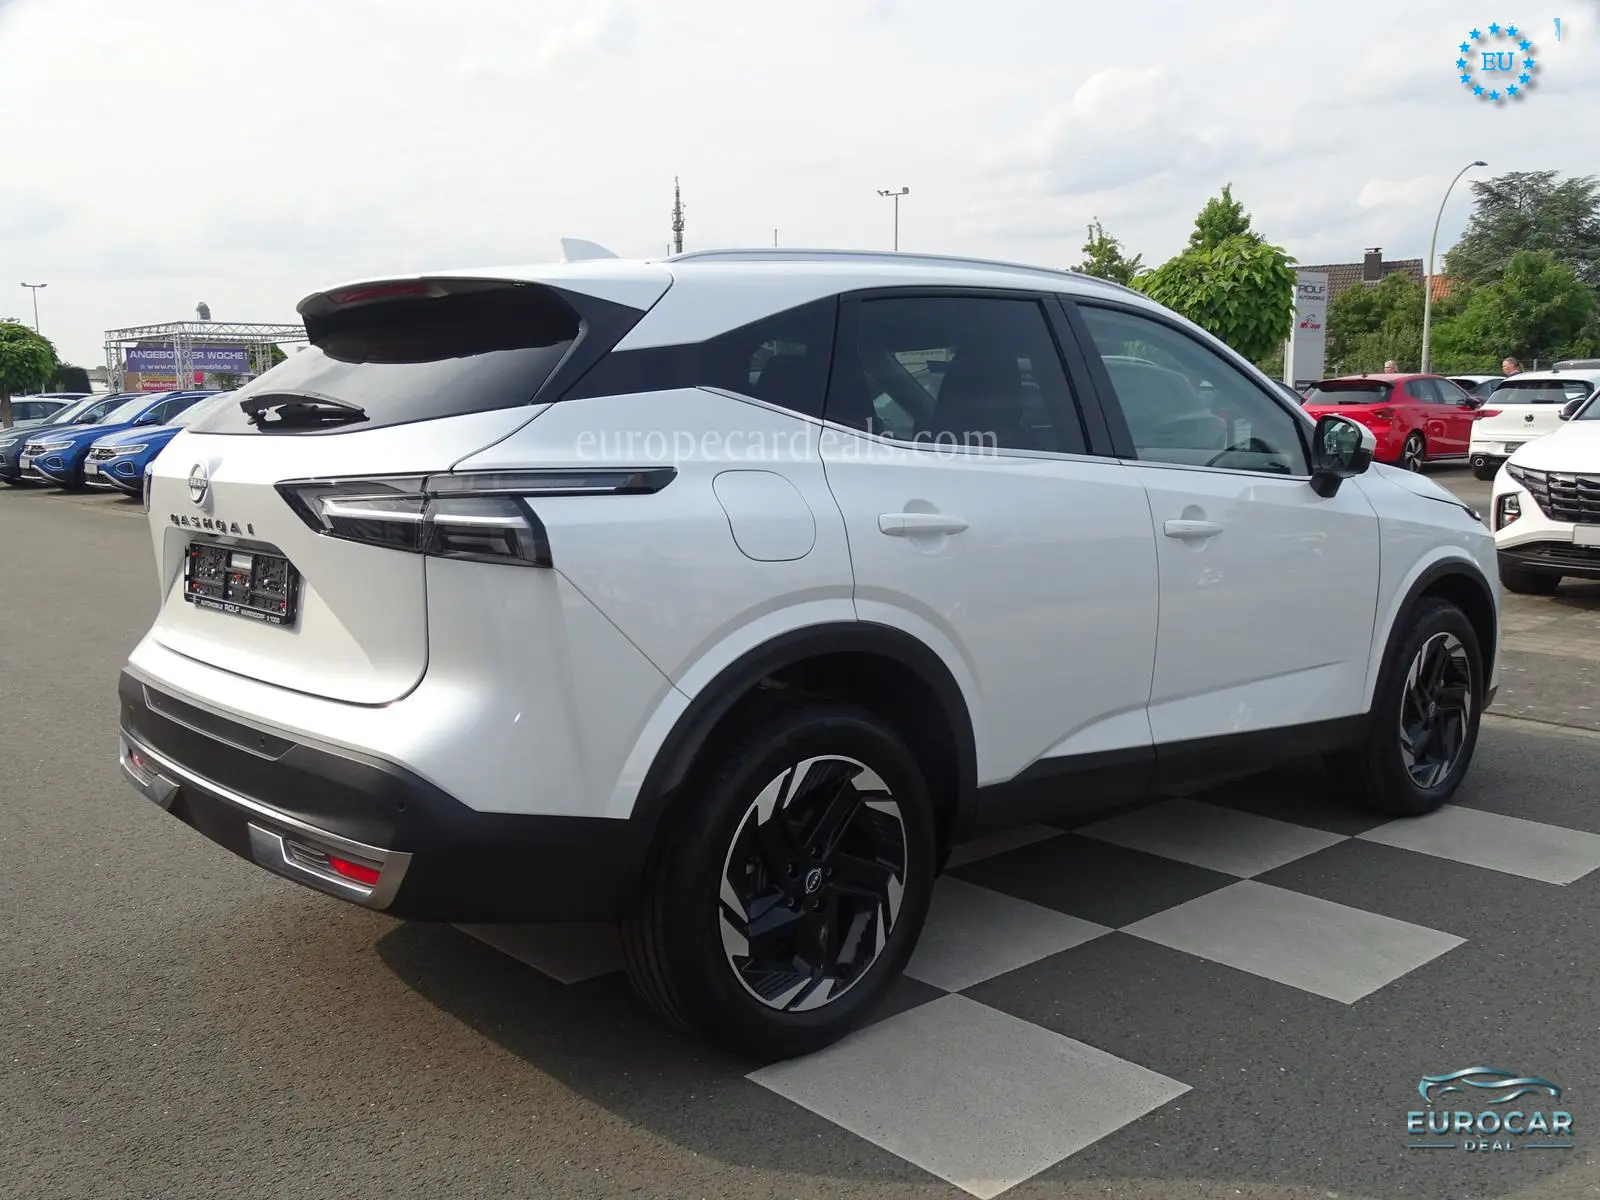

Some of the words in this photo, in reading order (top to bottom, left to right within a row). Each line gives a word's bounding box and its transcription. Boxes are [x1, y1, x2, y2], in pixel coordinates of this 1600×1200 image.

[1298, 285, 1325, 293] ROLF
[129, 350, 179, 360] ANGEBO
[170, 513, 255, 536] QASHQAI
[224, 603, 240, 614] ROLF
